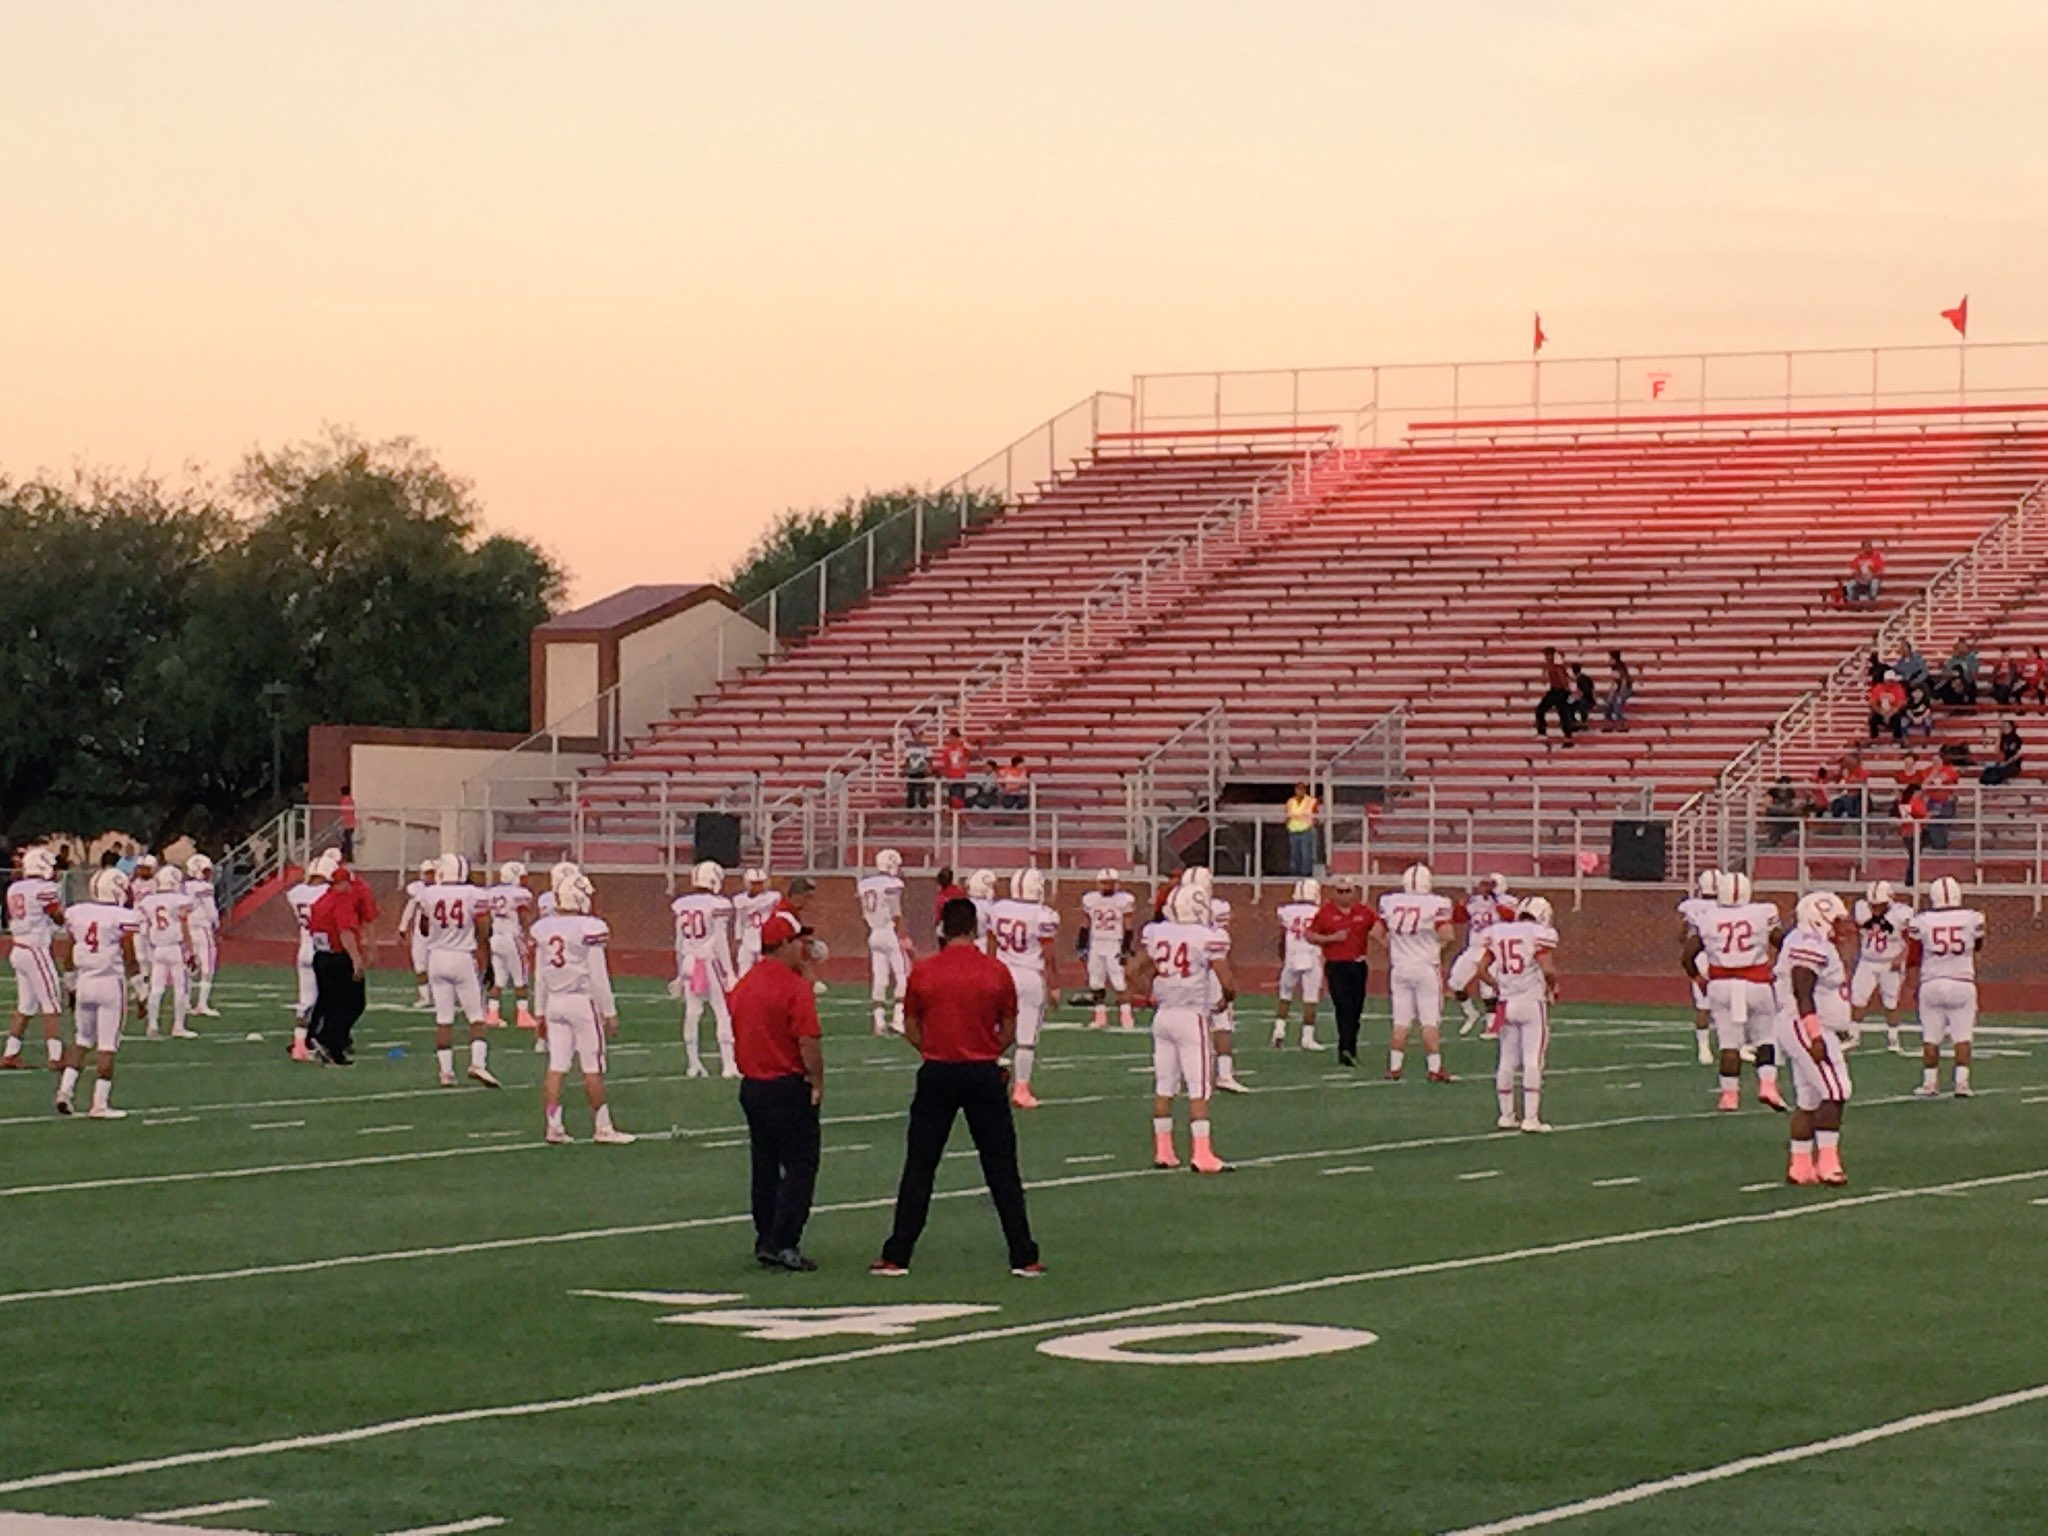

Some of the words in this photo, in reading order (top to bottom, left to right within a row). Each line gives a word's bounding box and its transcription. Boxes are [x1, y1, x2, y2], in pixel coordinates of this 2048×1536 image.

[1652, 380, 1666, 399] F
[434, 900, 463, 929] 44
[1393, 906, 1421, 936] 77
[84, 921, 99, 954] 4
[549, 935, 566, 969] 3
[996, 918, 1027, 953] 50
[1718, 920, 1753, 953] 72
[1932, 927, 1966, 956] 55
[1155, 941, 1191, 979] 24
[1499, 938, 1524, 975] 15
